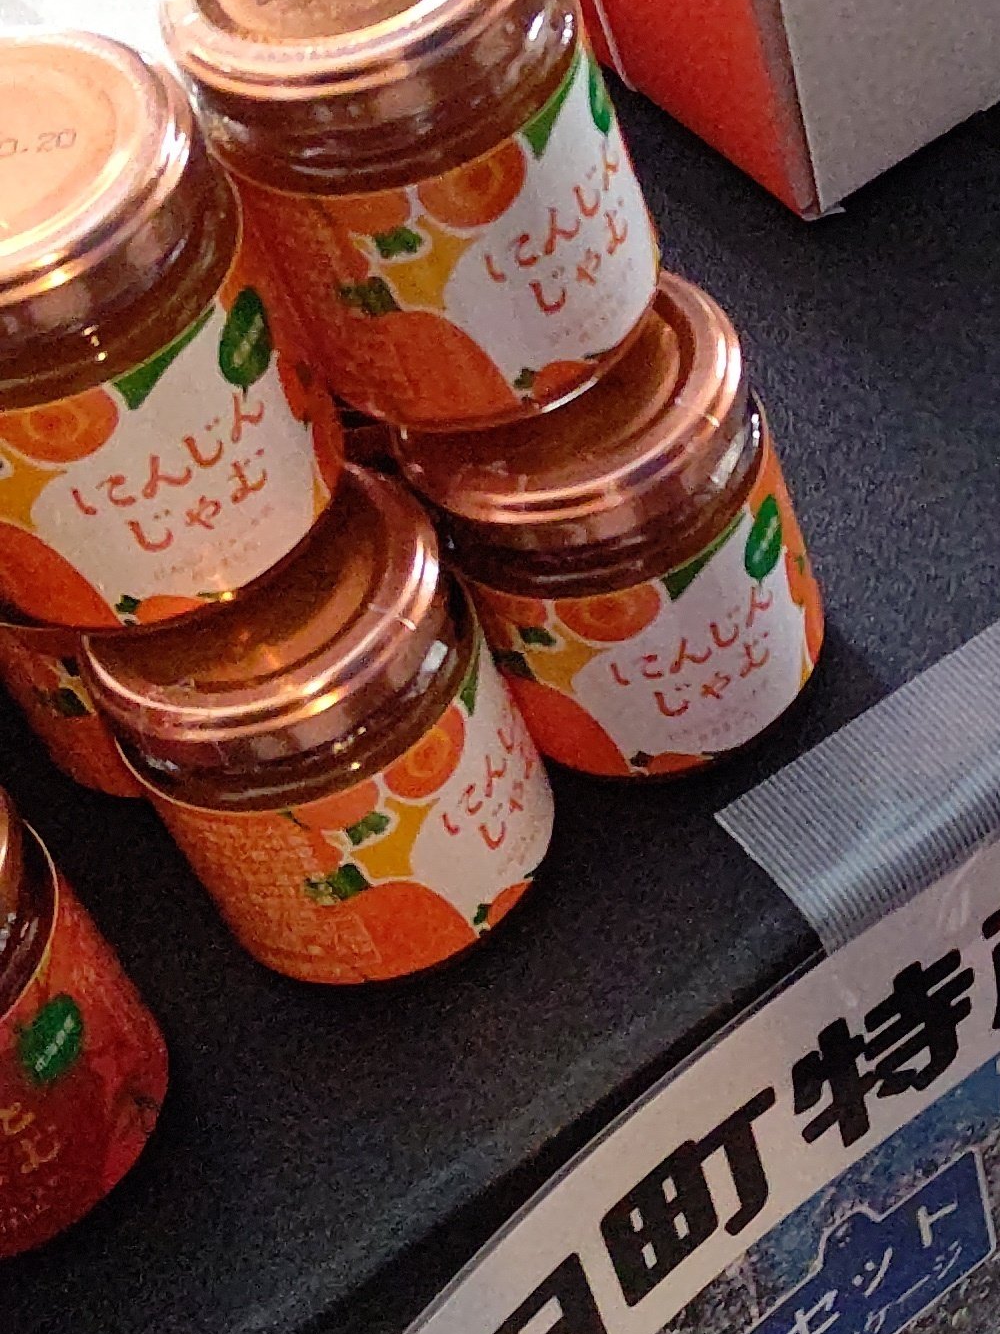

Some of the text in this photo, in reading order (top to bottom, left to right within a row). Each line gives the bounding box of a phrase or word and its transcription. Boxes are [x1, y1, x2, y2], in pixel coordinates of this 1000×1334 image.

[485, 143, 619, 283] にんじん
[528, 196, 628, 315] じゃむ
[71, 392, 265, 516] にんじん
[128, 447, 268, 553] じゃむ
[610, 586, 774, 686] にんじん
[654, 631, 771, 718] じゃむ
